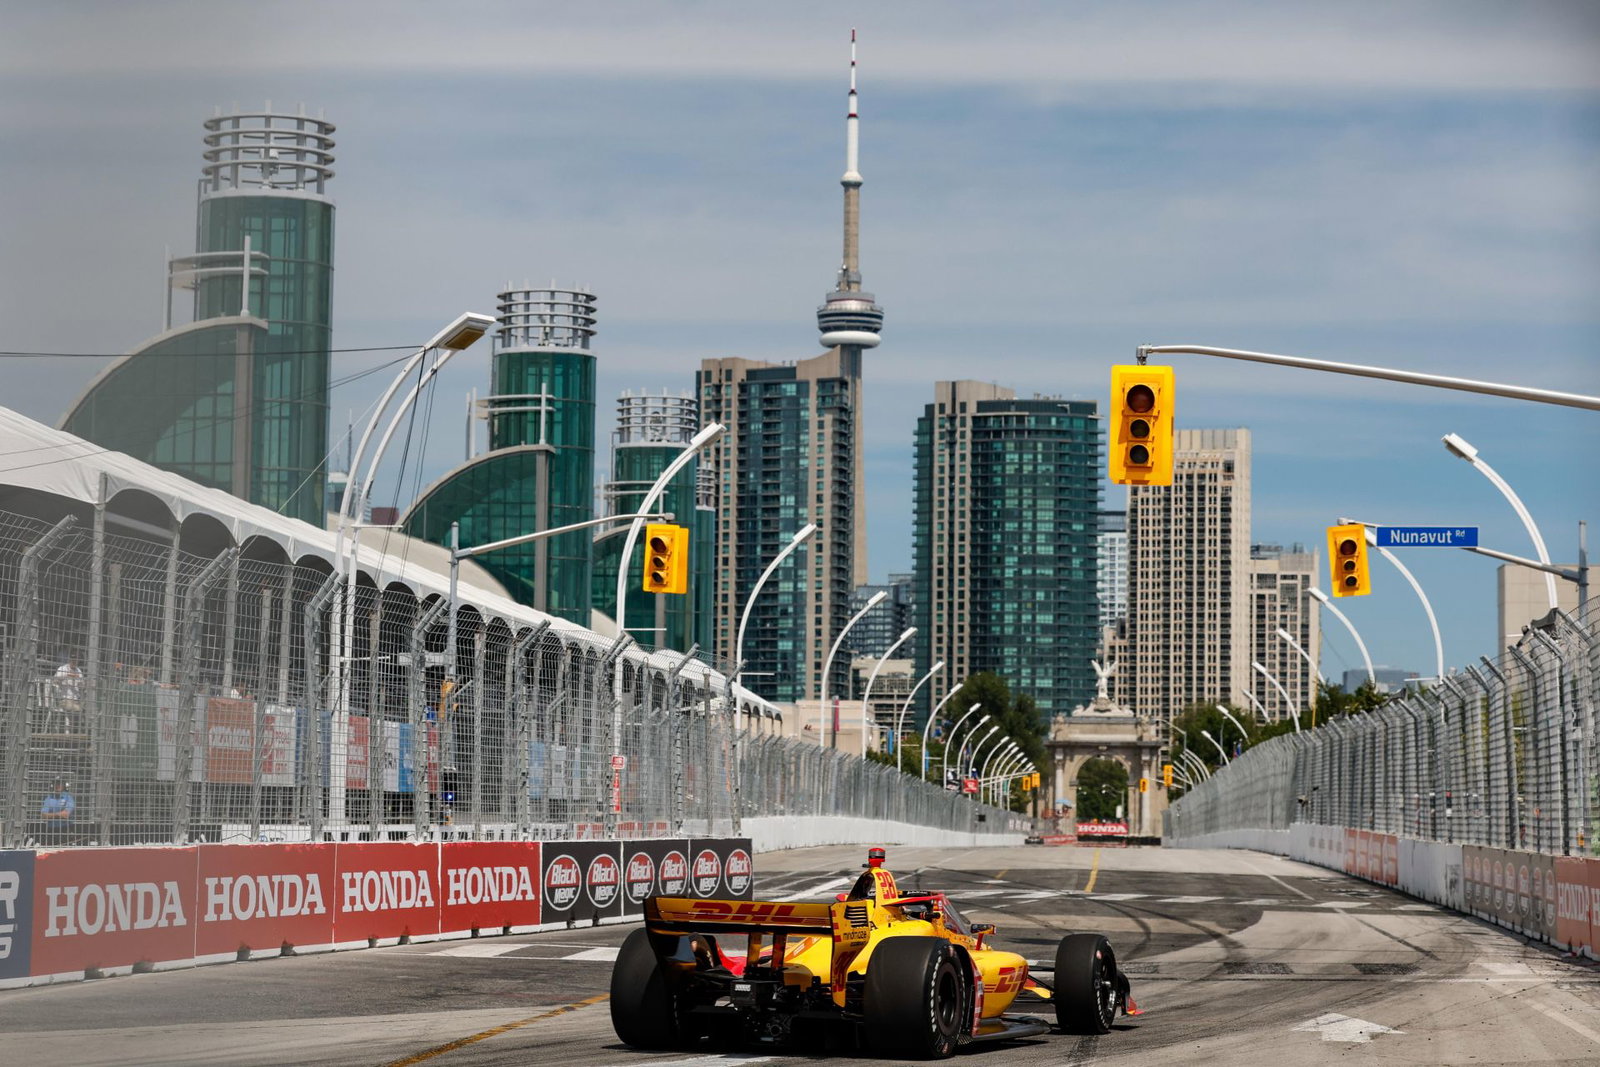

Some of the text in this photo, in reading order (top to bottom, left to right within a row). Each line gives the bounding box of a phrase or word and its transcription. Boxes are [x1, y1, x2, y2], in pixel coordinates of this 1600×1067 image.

[1390, 529, 1466, 544] Nunavut Rd
[1078, 824, 1128, 833] HONDA
[551, 863, 577, 885] Black
[592, 862, 616, 883] Black
[630, 860, 651, 880] Black
[663, 859, 684, 877] Black
[697, 857, 719, 875] Black
[729, 856, 749, 874] Black
[342, 869, 434, 913] HONDA
[447, 866, 535, 906] HONDA
[204, 873, 326, 922] HONDA
[1557, 882, 1590, 922] HONDA
[45, 881, 187, 937] HONDA
[691, 901, 805, 924] DHL
